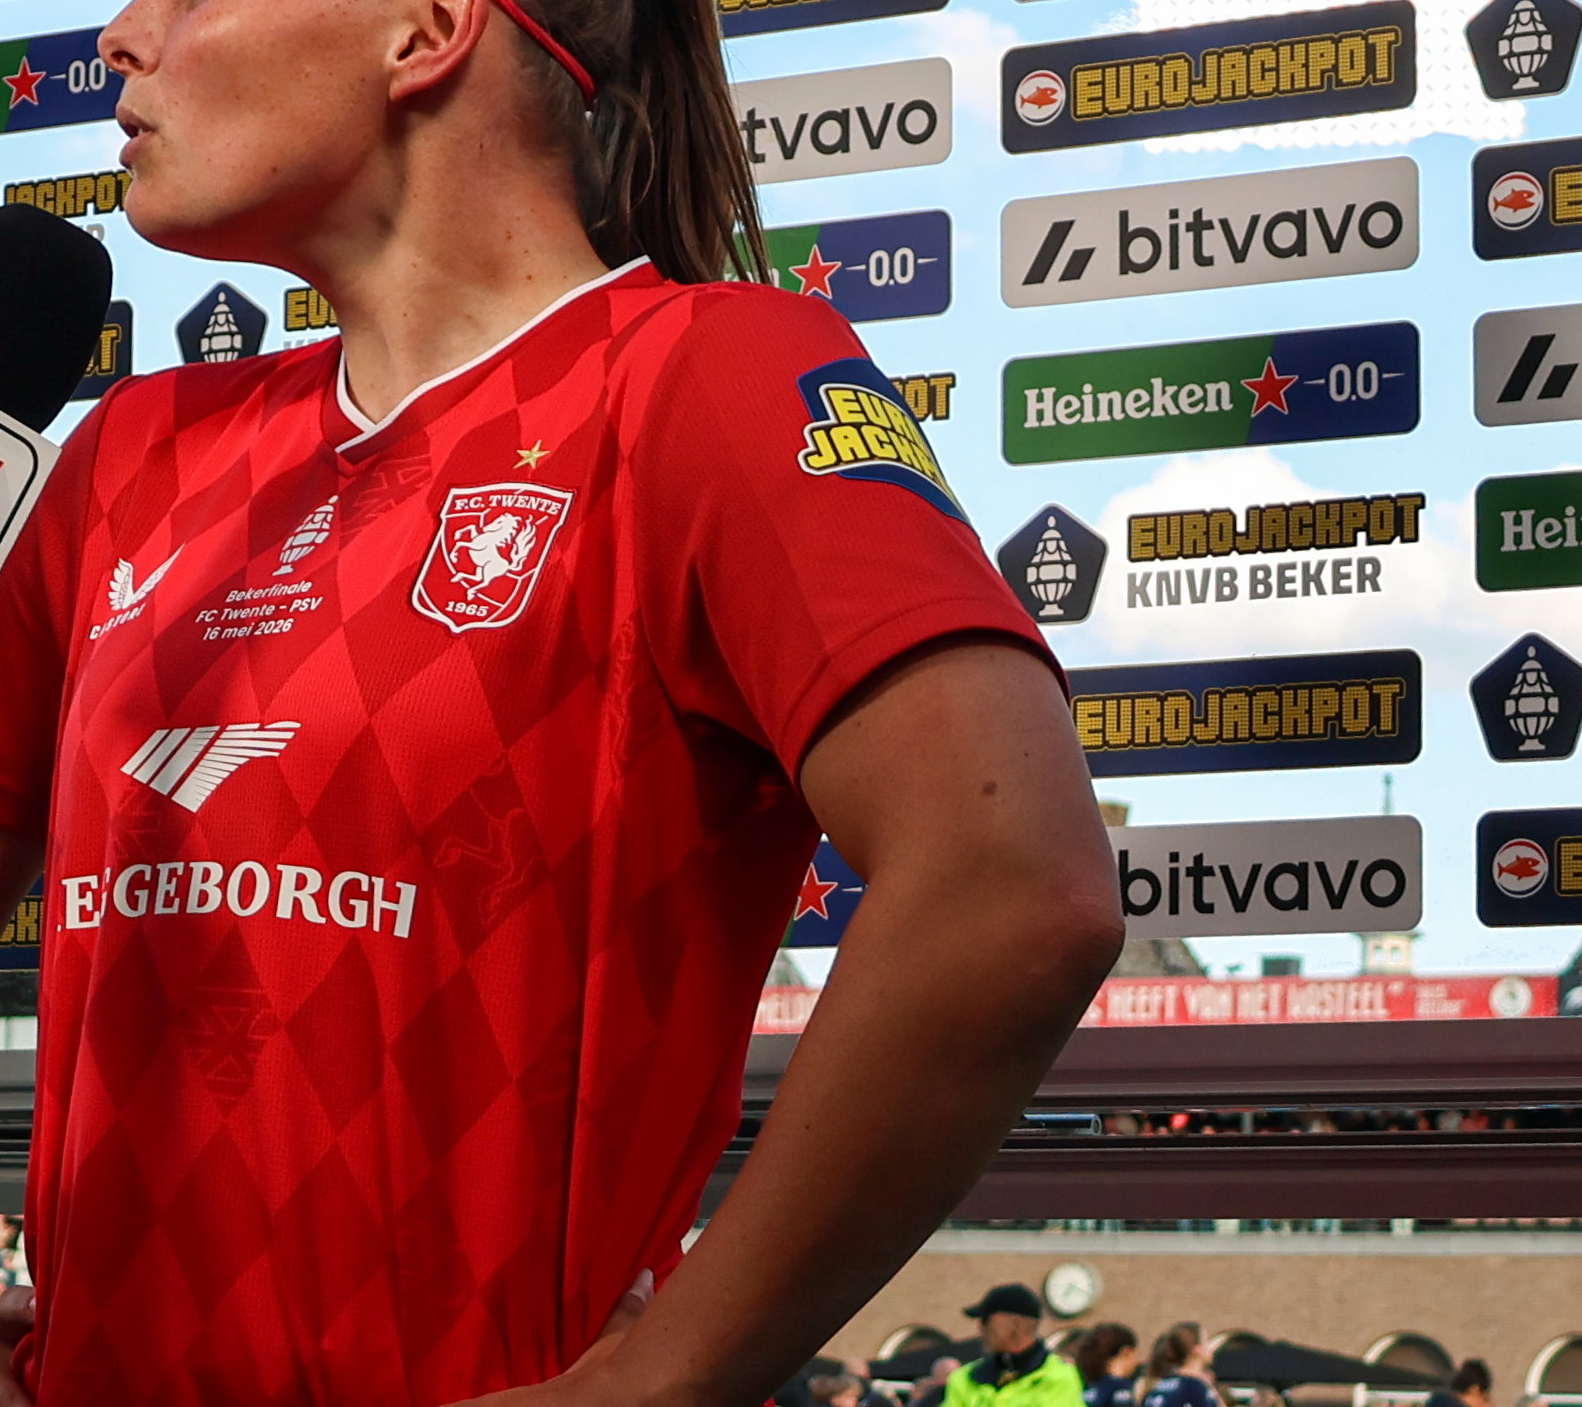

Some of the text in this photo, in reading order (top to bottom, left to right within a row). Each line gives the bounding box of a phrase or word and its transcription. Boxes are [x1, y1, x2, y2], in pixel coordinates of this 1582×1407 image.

[67, 57, 107, 94] 0.0
[1073, 30, 1399, 118] EUROJACKPOT
[740, 99, 937, 164] tvavo
[1119, 199, 1403, 275] bitvavo
[868, 247, 915, 287] 0.0
[1023, 360, 1380, 428] Heineken 0.0
[454, 494, 562, 515] F.C. TWENTE
[1127, 492, 1425, 564] EUROJACKPOT
[225, 580, 313, 604] Bekerfinale
[444, 600, 490, 618] 1965
[1126, 555, 1382, 609] KNVB BEKER
[195, 608, 216, 624] FC
[220, 604, 276, 623] Twente
[289, 596, 324, 614] PSV
[203, 618, 295, 641] 16 mei 2026
[1075, 681, 1403, 751] EUROJACKPOT
[1117, 849, 1406, 917] bitvavo
